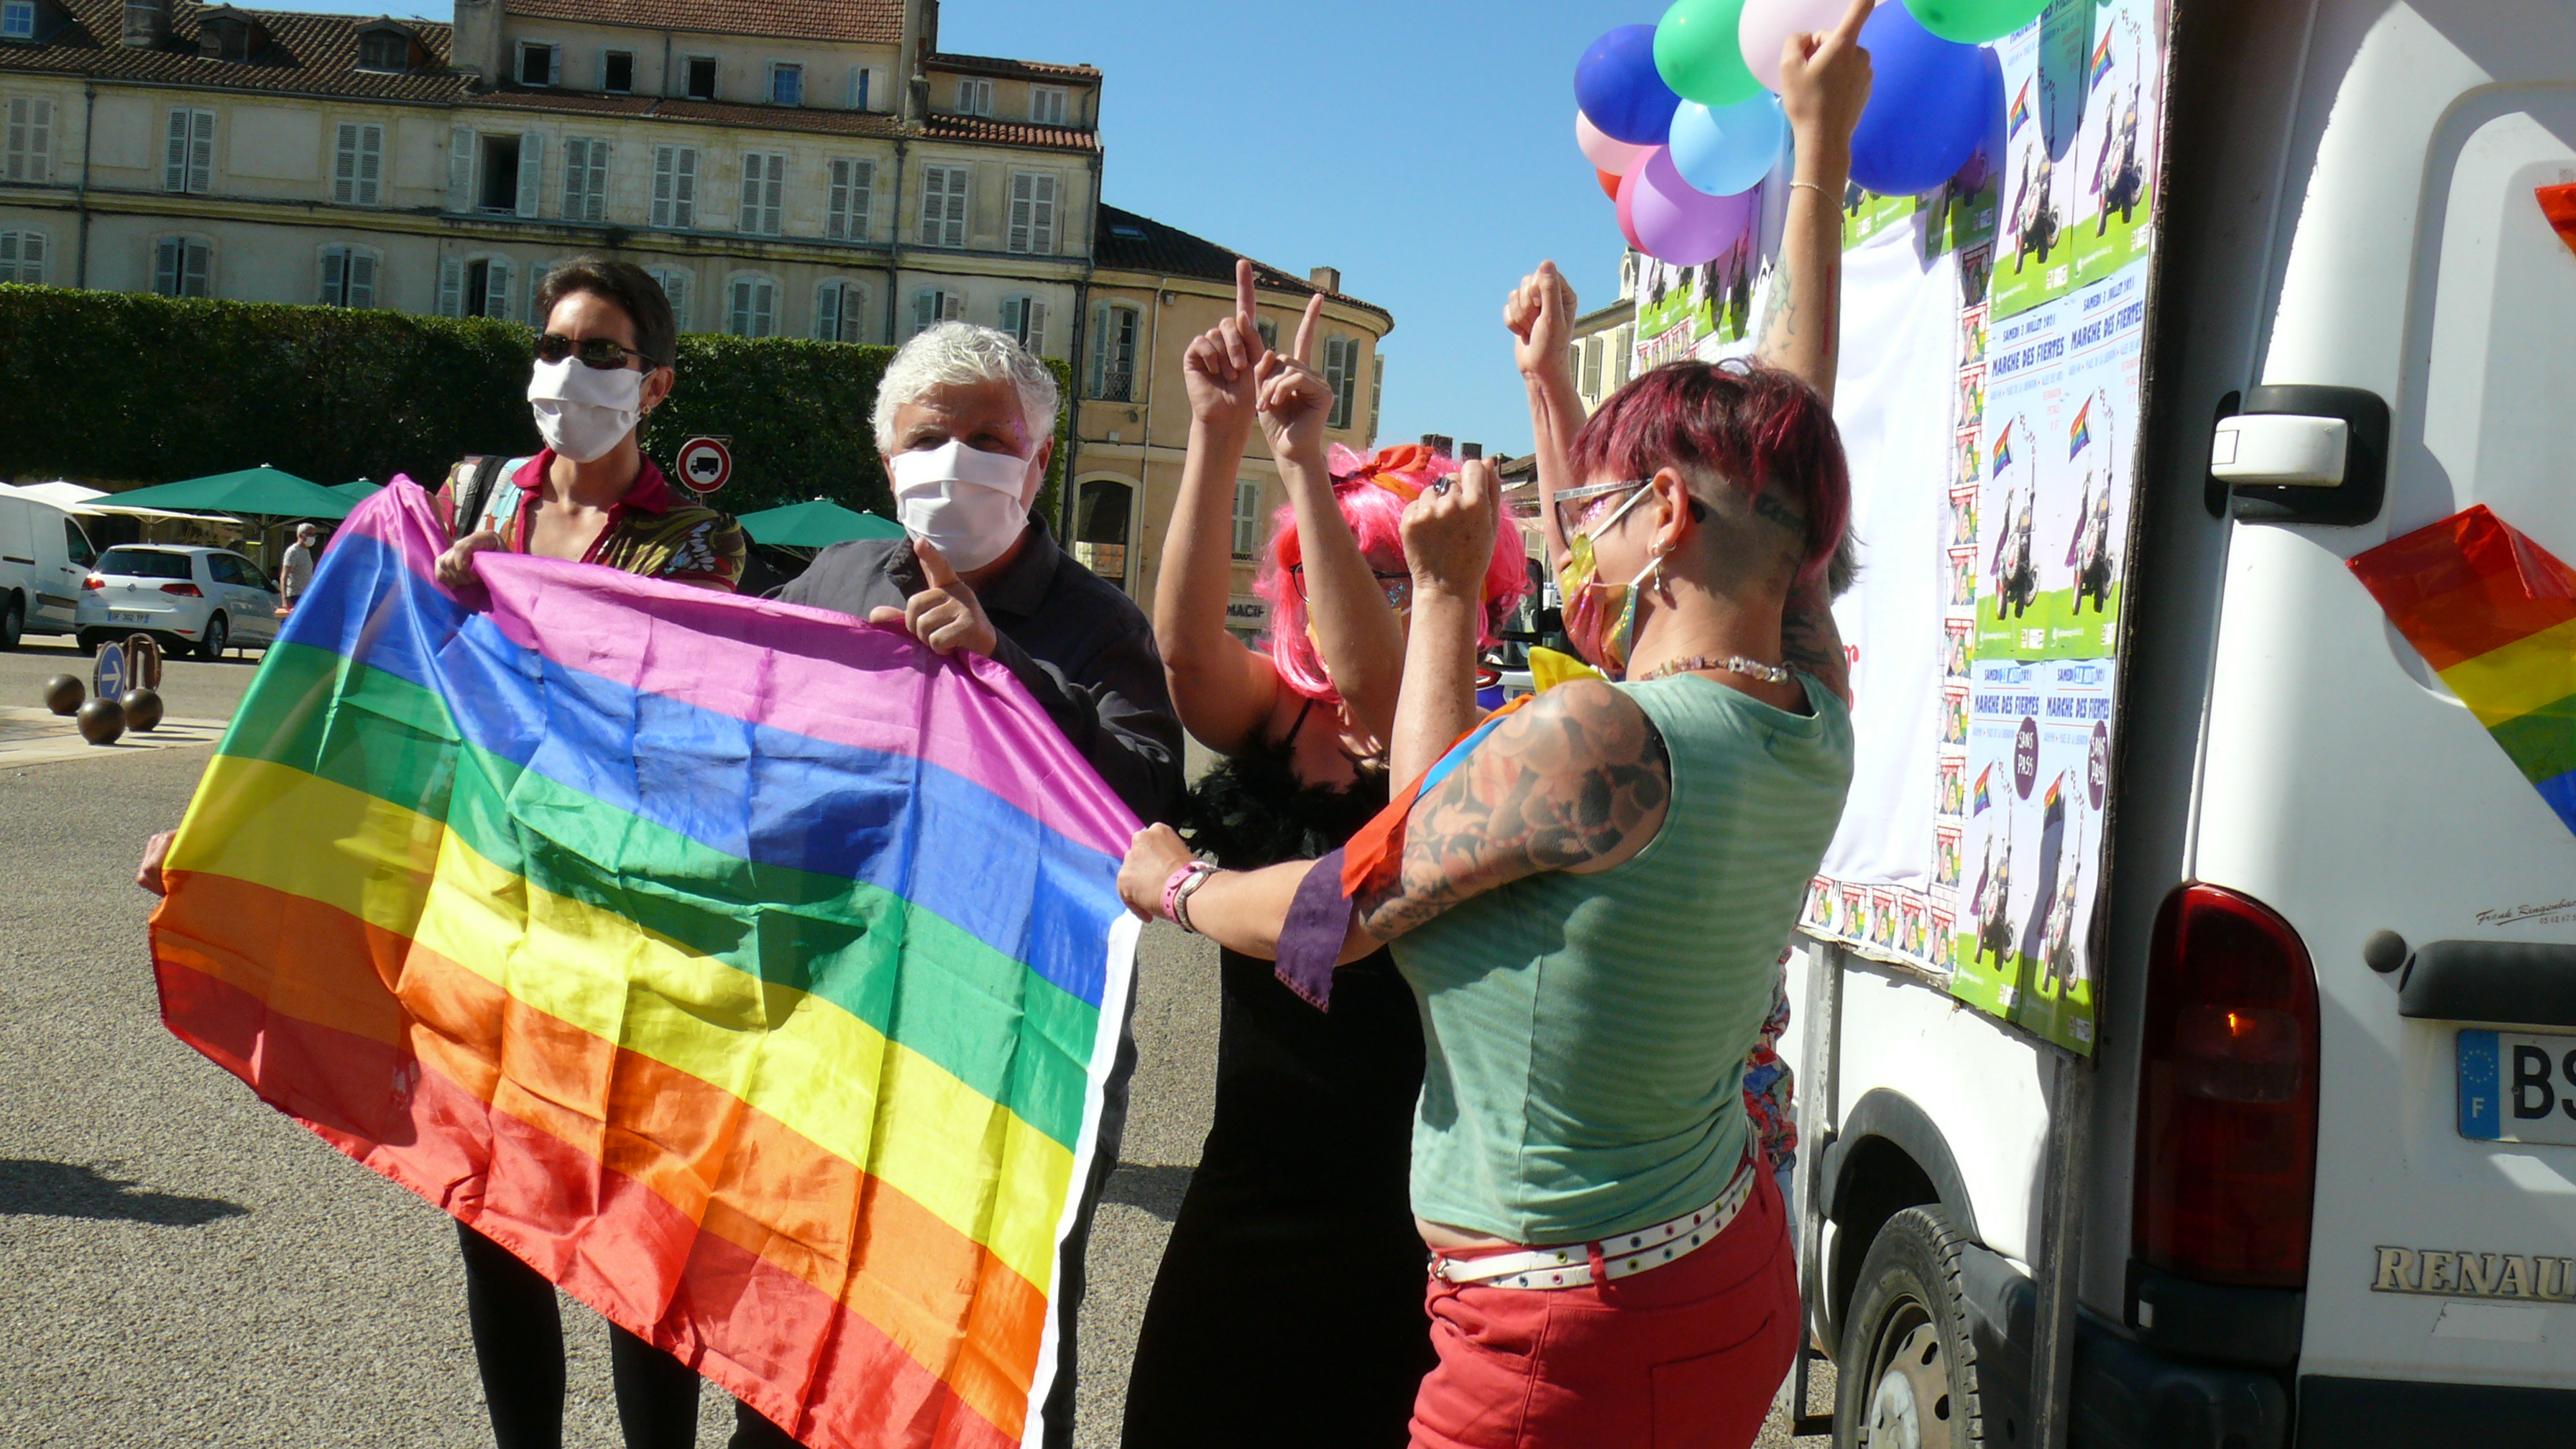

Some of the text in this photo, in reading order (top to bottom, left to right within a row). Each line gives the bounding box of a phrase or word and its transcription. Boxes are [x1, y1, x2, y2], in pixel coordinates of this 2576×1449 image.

[2083, 292, 2102, 312] SAMEDI
[2102, 290, 2107, 304] 3
[2107, 282, 2123, 302] JUILLET
[2002, 326, 2020, 342] SAMEDI
[2020, 324, 2025, 336] 3
[2025, 318, 2042, 335] JUILLET
[2071, 321, 2102, 351] MARCHE
[2103, 313, 2115, 338] DES
[1992, 351, 2020, 377] MARCHE
[2022, 346, 2035, 368] DES
[1226, 604, 1265, 617] MACIF
[1984, 669, 2000, 681] SAMEDI
[2057, 668, 2074, 681] SAMEDI
[1974, 695, 2000, 714] MARCHE
[2001, 696, 2013, 714] DES
[2046, 696, 2074, 718] MARCHE
[2075, 697, 2087, 719] DES
[2018, 731, 2033, 750] SANS
[2090, 737, 2106, 758] SANS
[2018, 754, 2033, 776] PASS
[2472, 1098, 2485, 1118] F
[2370, 1245, 2576, 1302] RENAU
